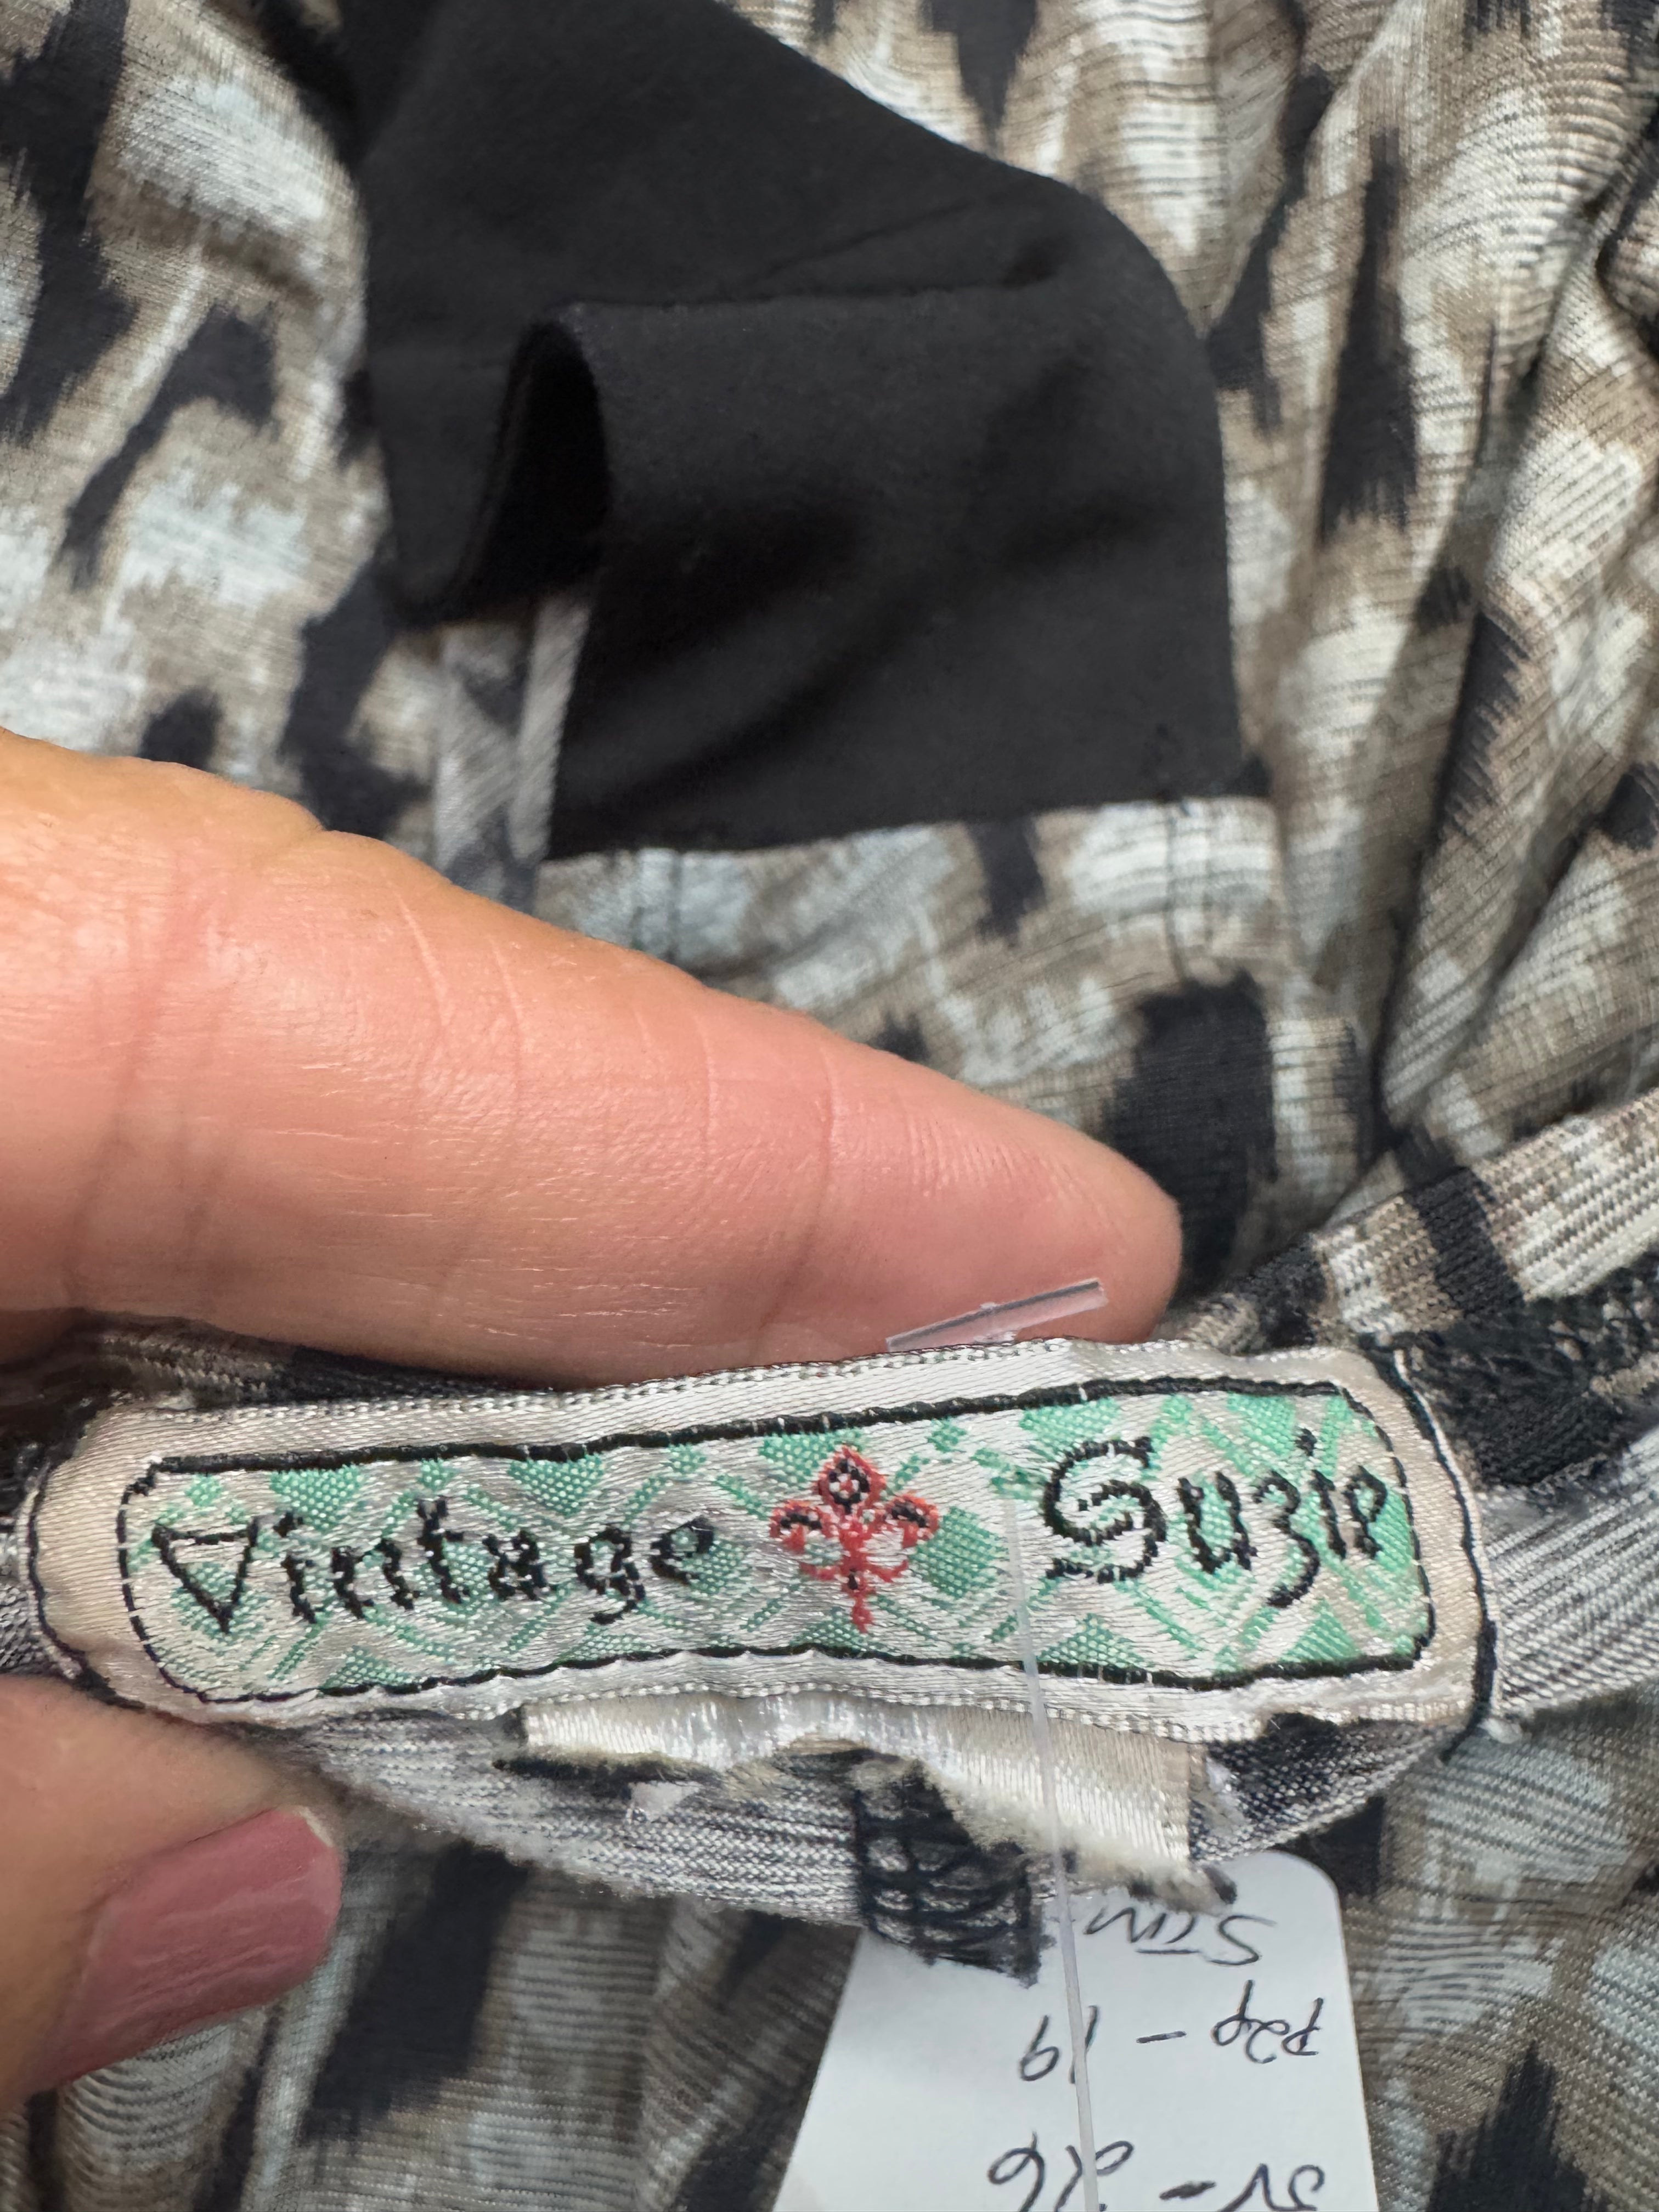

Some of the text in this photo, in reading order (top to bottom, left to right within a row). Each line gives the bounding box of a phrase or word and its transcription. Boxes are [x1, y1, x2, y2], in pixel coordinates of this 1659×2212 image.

[151, 1428, 1388, 1634] Vintage Suzie
[1019, 2005, 1100, 2083] 19
